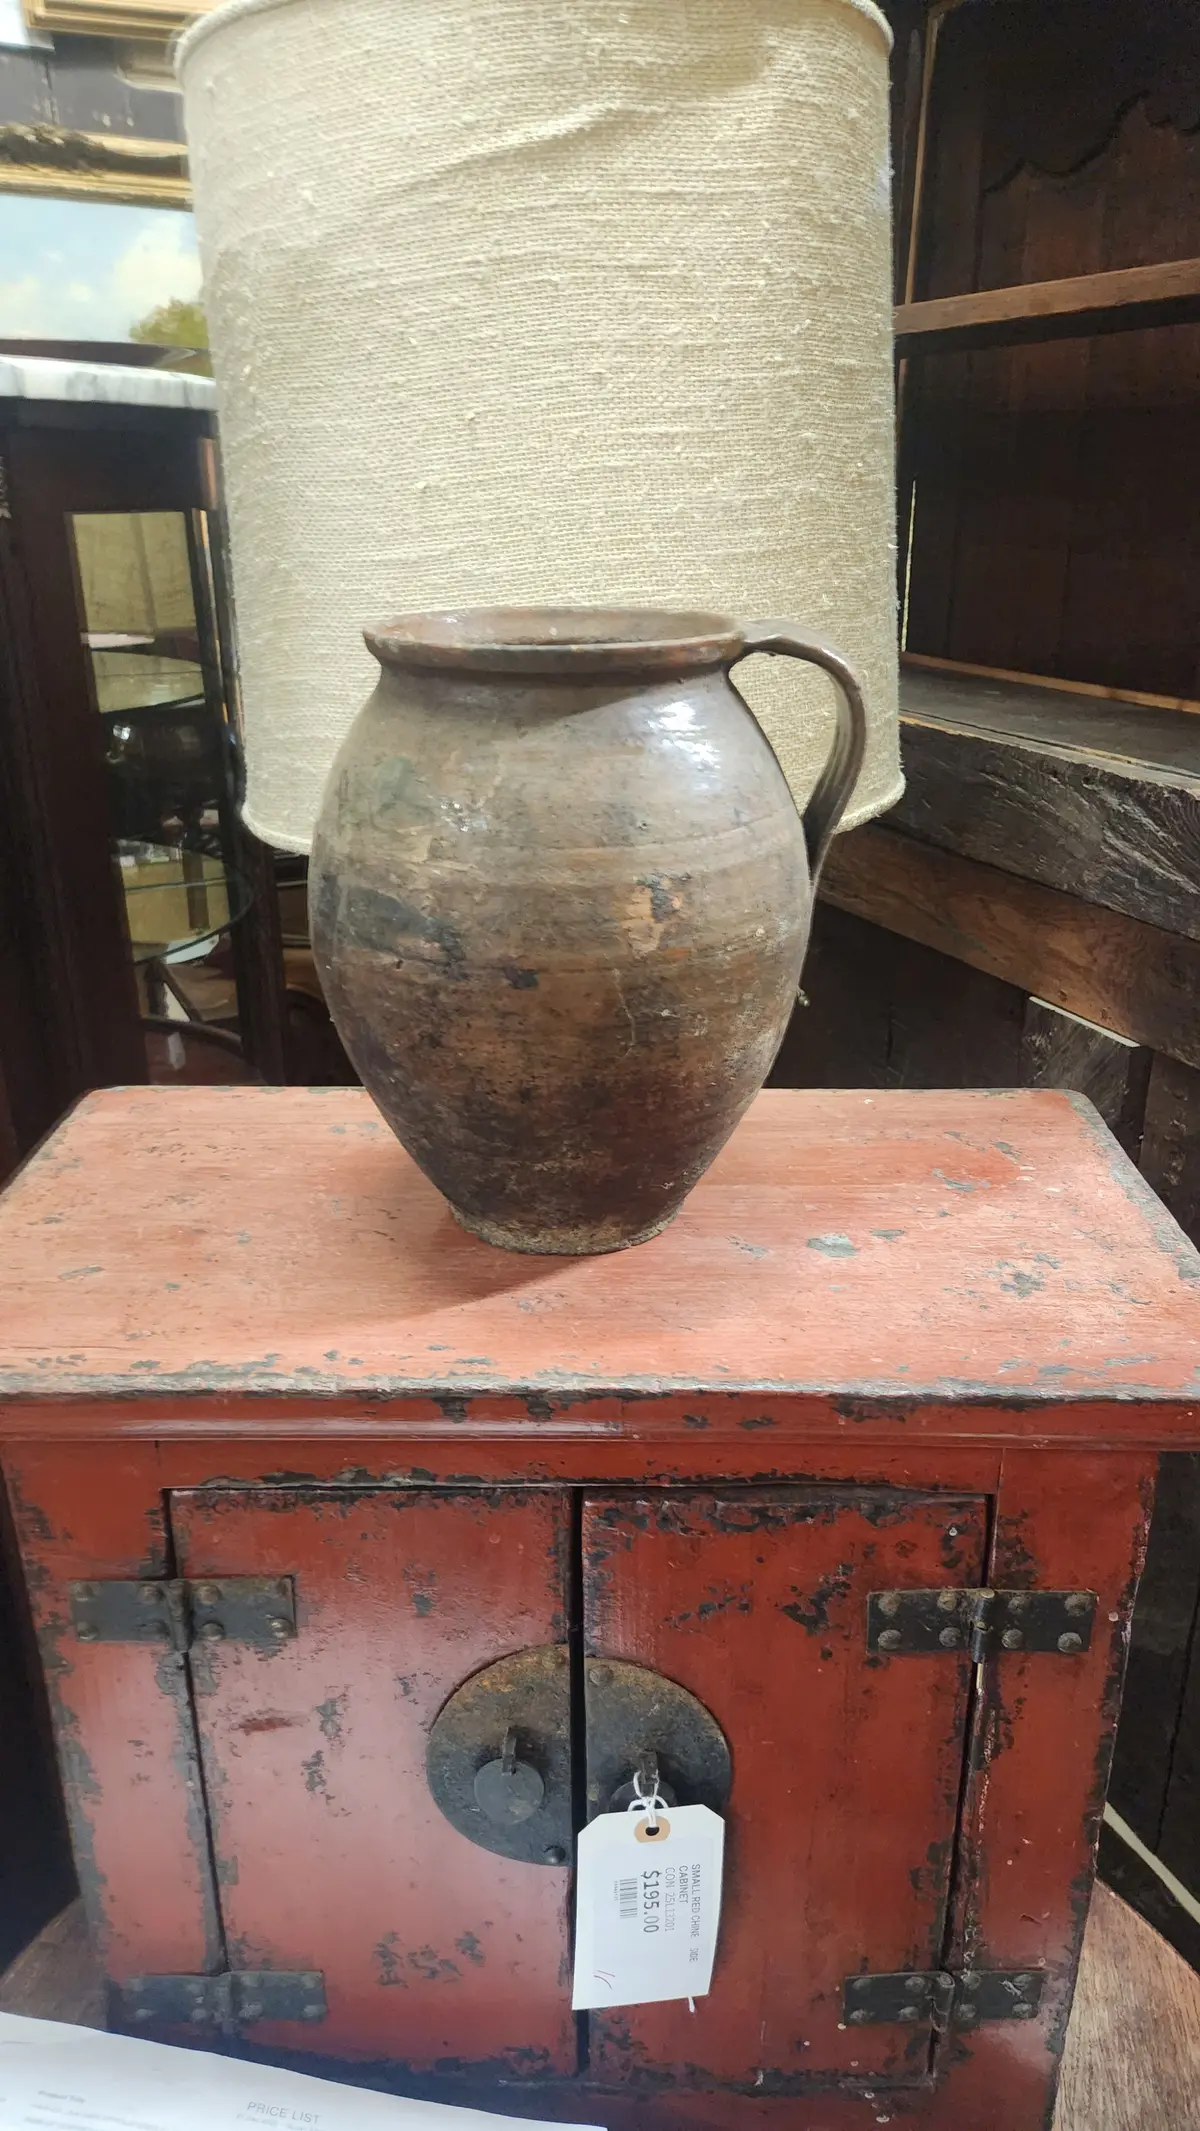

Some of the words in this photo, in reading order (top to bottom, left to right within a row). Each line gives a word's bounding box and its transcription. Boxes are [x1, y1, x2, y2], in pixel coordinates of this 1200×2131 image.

[665, 1867, 675, 1888] CON
[679, 1865, 689, 1904] CABINET
[691, 1863, 701, 1896] SMALL
[641, 1870, 663, 1933] $195.00
[691, 1896, 701, 1913] RED
[247, 2101, 289, 2119] PRICE
[291, 2109, 322, 2124] LIST
